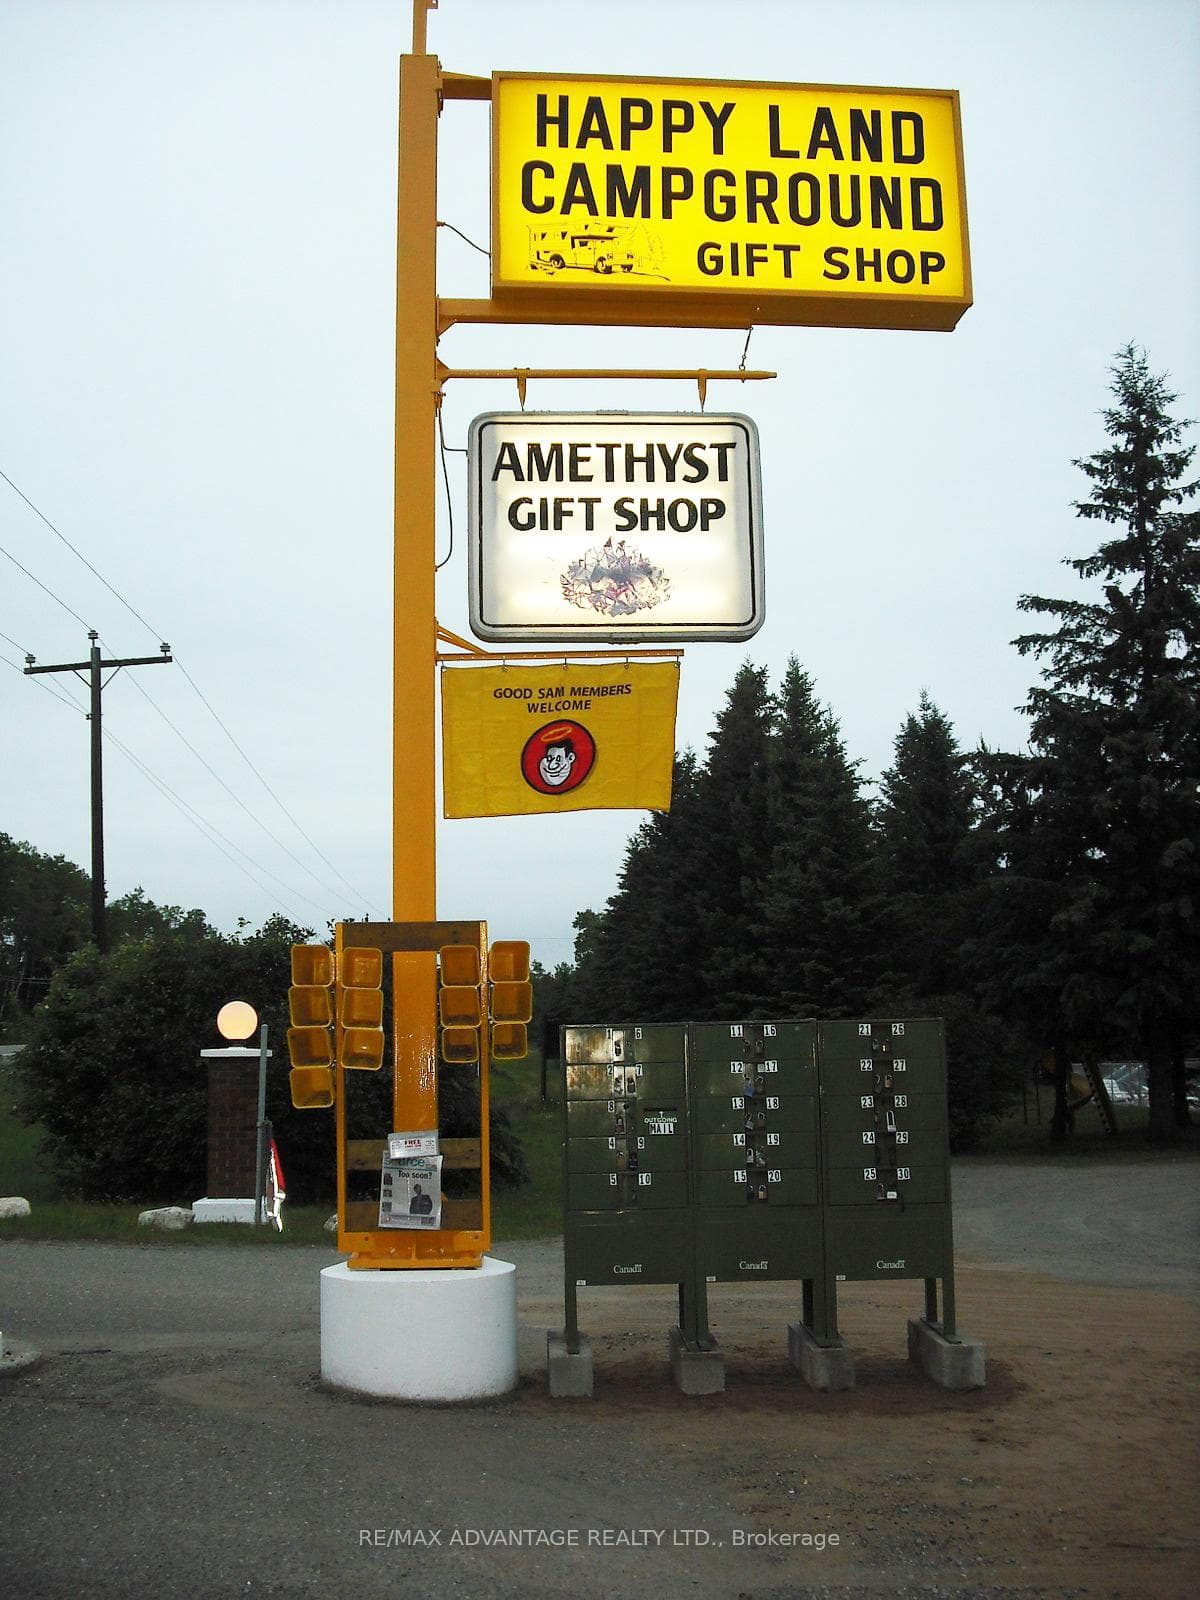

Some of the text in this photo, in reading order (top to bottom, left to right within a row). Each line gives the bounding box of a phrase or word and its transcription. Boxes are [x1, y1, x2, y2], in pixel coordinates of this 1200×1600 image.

[536, 93, 925, 165] HAPPY LAND
[521, 160, 944, 232] CAMPGROUND
[696, 241, 946, 285] GIFT SHOP
[491, 442, 737, 483] AMETHYST
[507, 497, 726, 532] GIFT SHOP
[493, 684, 632, 700] GOOD SAM MEMBERS
[527, 700, 592, 714] WELCOME
[607, 1029, 612, 1039] 1
[636, 1029, 641, 1038] 6
[732, 1026, 742, 1037] 11
[765, 1025, 775, 1035] 16
[860, 1024, 870, 1034] 21
[893, 1024, 903, 1034] 26
[607, 1065, 613, 1075] 2
[636, 1065, 643, 1075] 7
[732, 1063, 742, 1072] 12
[766, 1061, 777, 1071] 17
[861, 1060, 871, 1070] 22
[894, 1060, 905, 1070] 27
[733, 1098, 743, 1108] 13
[768, 1098, 778, 1108] 18
[862, 1097, 872, 1107] 23
[896, 1096, 906, 1107] 28
[650, 1124, 673, 1134] MAIL
[734, 1135, 744, 1145] 14
[768, 1134, 778, 1144] 19
[864, 1133, 874, 1143] 24
[897, 1132, 907, 1143] 29
[609, 1138, 615, 1148] 4
[638, 1138, 644, 1148] 9
[398, 1170, 410, 1178] Too
[735, 1171, 746, 1182] 15
[769, 1171, 780, 1181] 20
[865, 1169, 875, 1179] 25
[898, 1168, 909, 1179] 30
[610, 1174, 616, 1184] 5
[640, 1174, 650, 1184] 10
